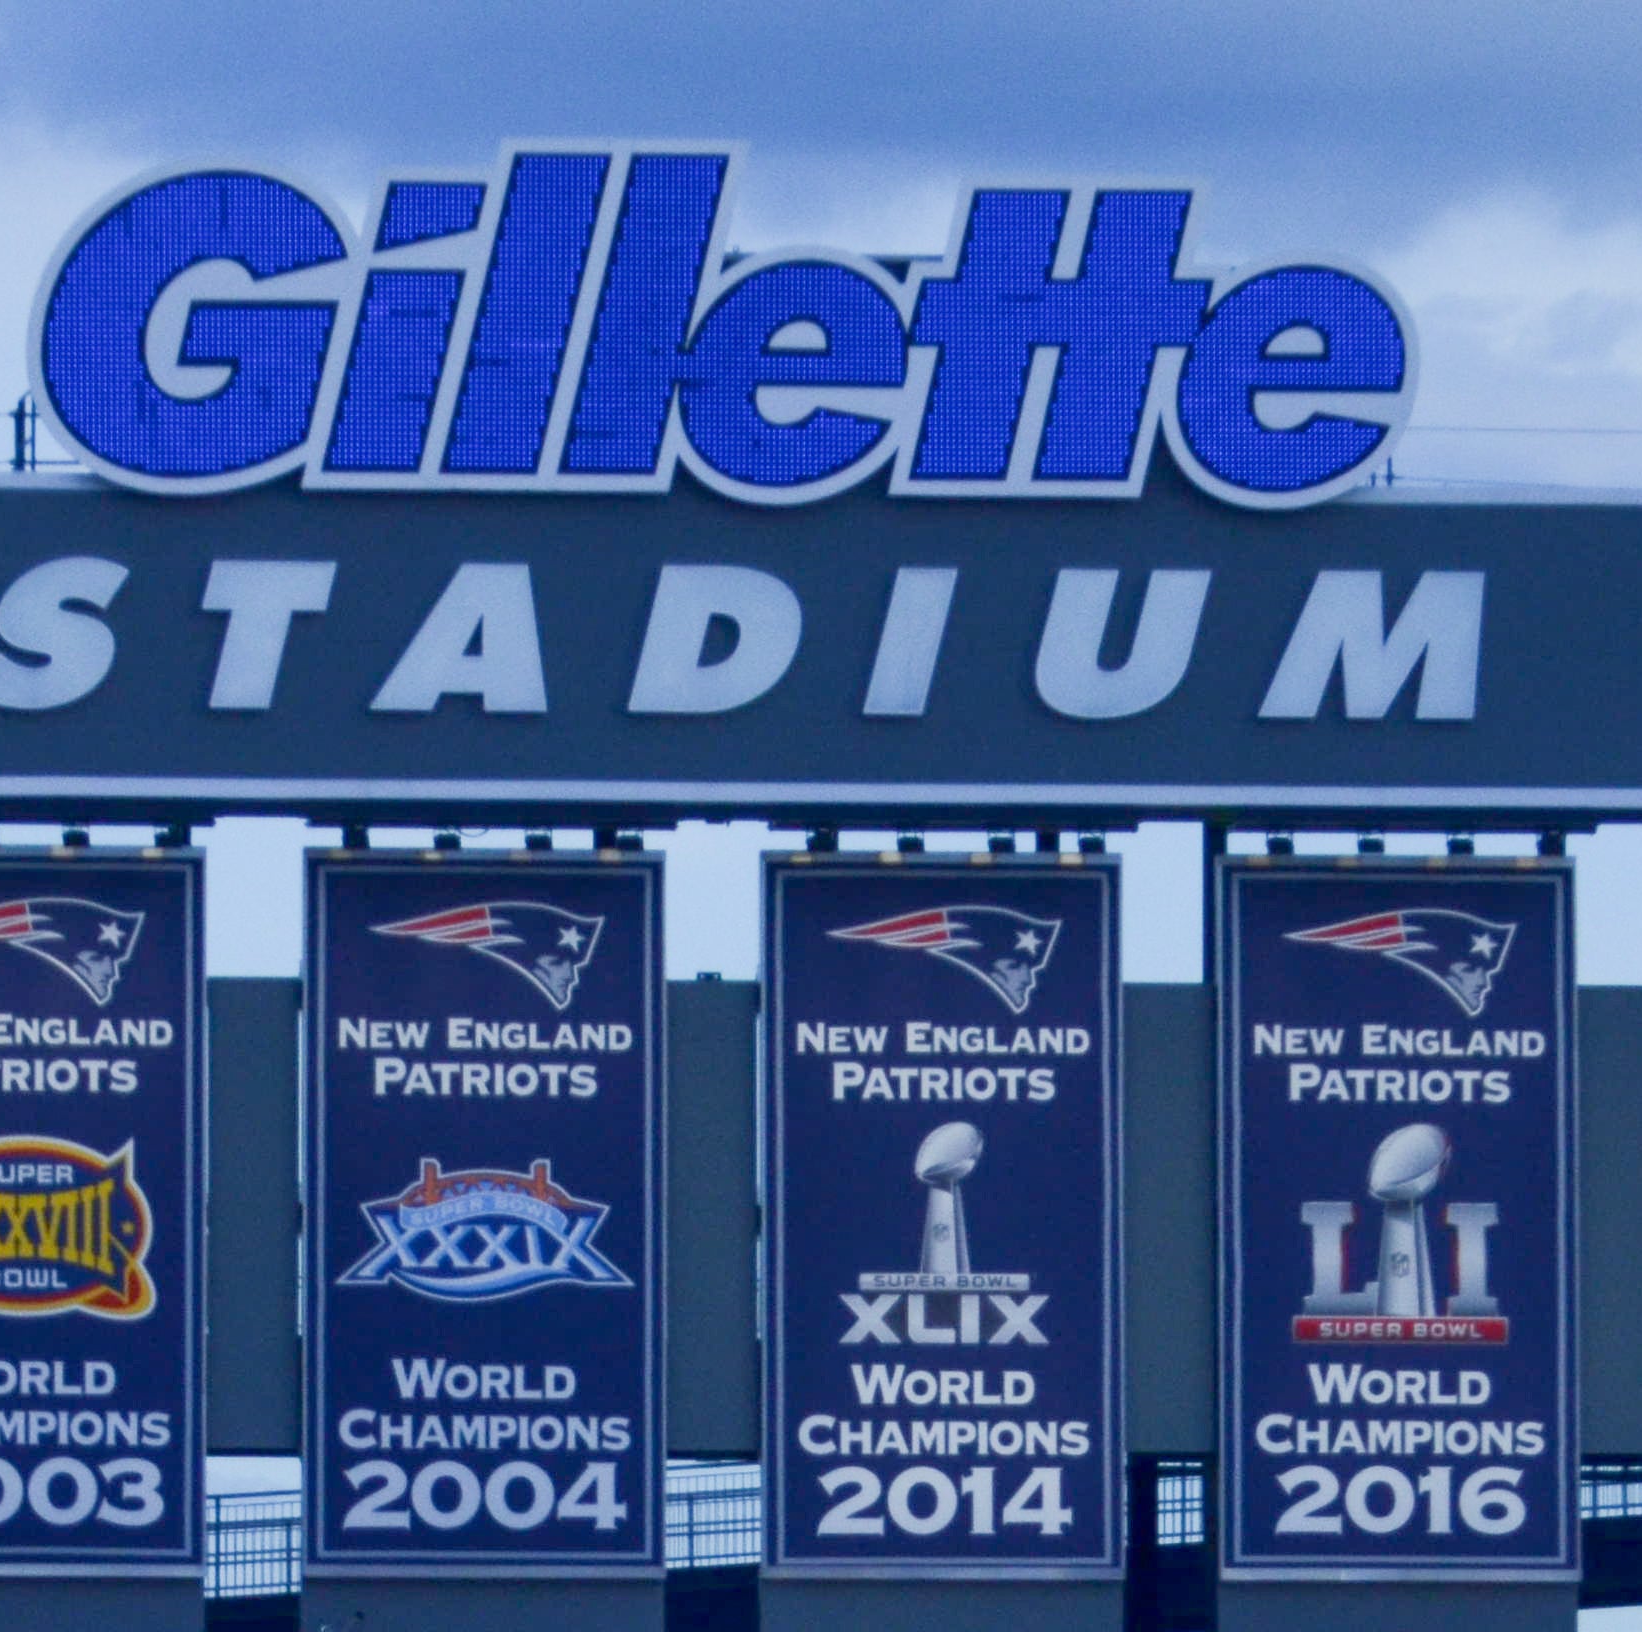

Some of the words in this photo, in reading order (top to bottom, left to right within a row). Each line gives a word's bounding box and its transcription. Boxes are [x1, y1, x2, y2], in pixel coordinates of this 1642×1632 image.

[42, 150, 1407, 490] Gillette
[339, 1018, 429, 1048] NEW
[448, 1018, 632, 1050] ENGLAND
[797, 1022, 888, 1053] NEW
[906, 1022, 1090, 1054] ENGLAND
[1254, 1024, 1344, 1054] NEW
[1362, 1024, 1545, 1057] ENGLAND
[375, 1057, 597, 1097] PATRIOTS
[833, 1062, 1055, 1101] PATRIOTS
[1290, 1063, 1510, 1103] PATRIOTS
[408, 1198, 484, 1226] SUPER
[495, 1199, 558, 1226] BOWL
[357, 1213, 615, 1278] XXXIX
[873, 1275, 947, 1288] SUPER
[957, 1275, 1018, 1288] BOWL
[838, 1293, 1051, 1345] XLIX
[1319, 1322, 1402, 1338] SUPER
[1413, 1322, 1483, 1338] BOWL
[392, 1358, 575, 1399] WORLD
[851, 1364, 1035, 1405] WORLD
[1308, 1364, 1490, 1405] WORLD
[339, 1408, 630, 1451] CHAMPIONS
[799, 1415, 1089, 1455] CHAMPIONS
[1256, 1414, 1544, 1455] CHAMPIONS
[343, 1460, 627, 1529] 2004
[818, 1466, 1072, 1535] 2014
[1276, 1465, 1525, 1534] 2016
